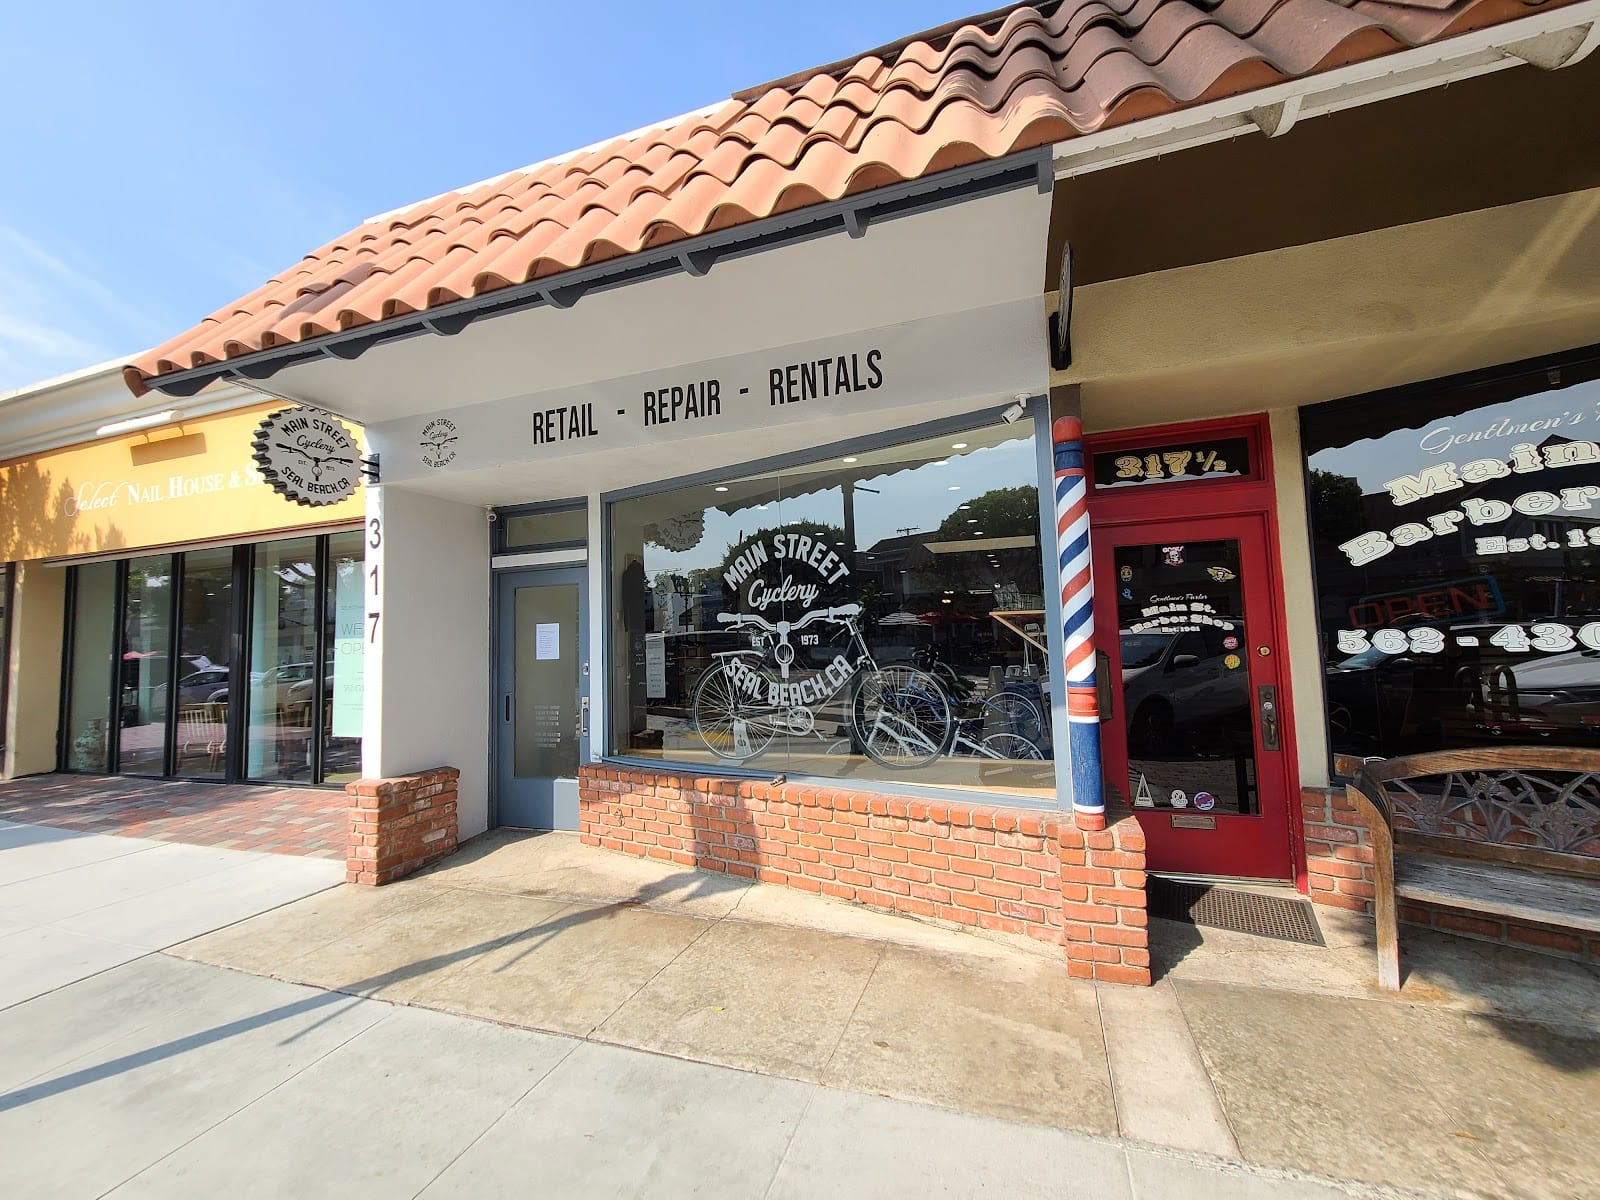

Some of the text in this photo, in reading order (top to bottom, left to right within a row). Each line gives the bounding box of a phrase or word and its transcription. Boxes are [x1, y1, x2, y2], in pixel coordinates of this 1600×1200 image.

[533, 402, 599, 446] RETAIL
[643, 379, 722, 427] REPAIR
[768, 348, 884, 407] RENTALS
[281, 417, 351, 450] MAIN STREET
[422, 418, 457, 437] MAIN STREET
[296, 434, 336, 455] Cyclery
[281, 466, 304, 489] SEAL
[1383, 440, 1600, 506] Main
[64, 481, 130, 516] Select
[229, 470, 241, 489] &
[1338, 485, 1600, 567] Barber
[1474, 533, 1561, 555] Est.
[723, 533, 850, 592] MAIN STREET
[748, 574, 819, 611] Cyclery
[1349, 583, 1490, 628] OPEN
[1129, 613, 1235, 634] Barber Shop
[1141, 602, 1188, 617] Main
[751, 636, 765, 647] EST
[801, 634, 819, 646] 1973
[726, 657, 762, 700] SEAL
